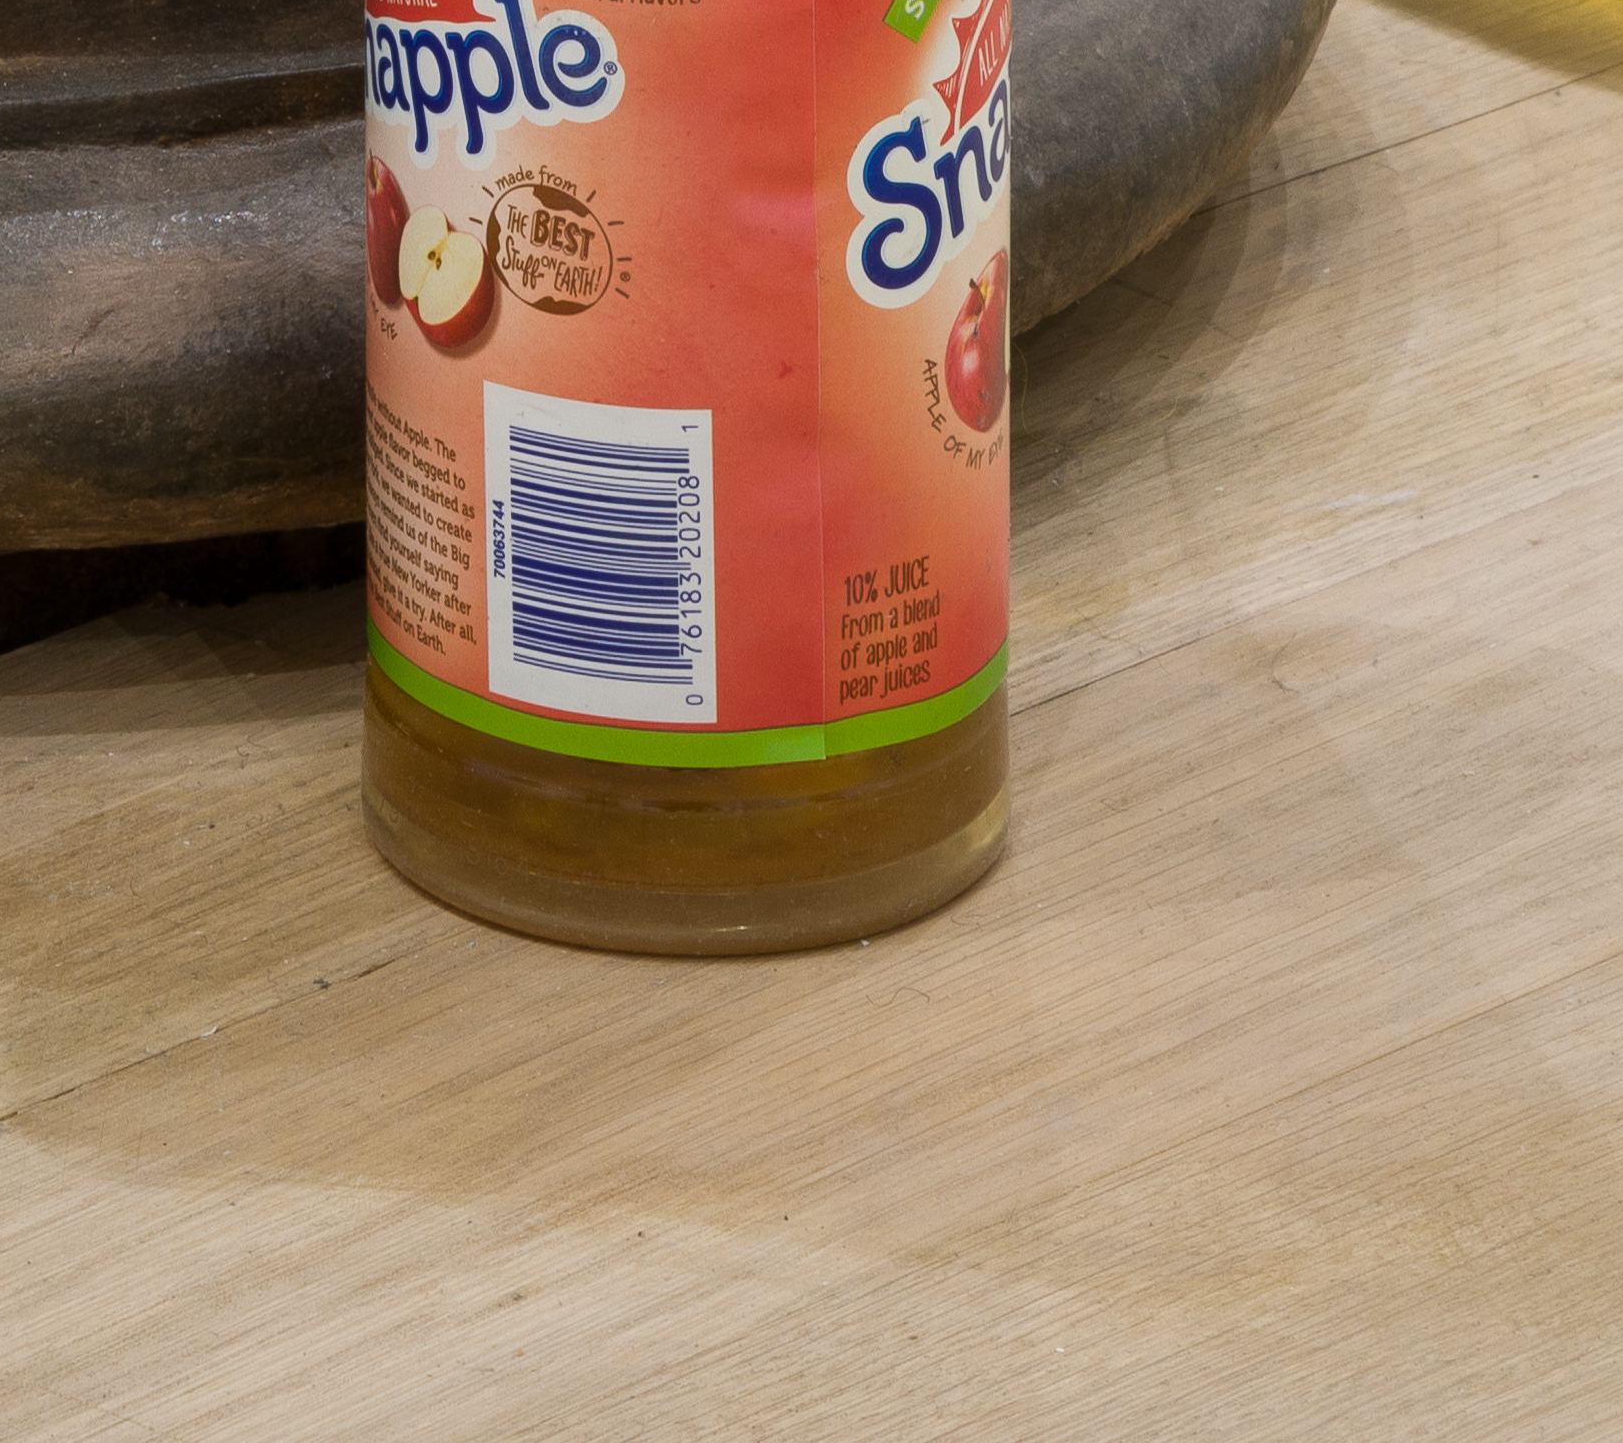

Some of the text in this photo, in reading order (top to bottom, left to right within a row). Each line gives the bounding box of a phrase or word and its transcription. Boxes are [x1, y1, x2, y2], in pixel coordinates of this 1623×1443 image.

[977, 29, 1000, 88] ALL
[494, 163, 579, 197] made from
[506, 203, 596, 262] THE BEST
[501, 233, 603, 299] Stuff ON EARTH!
[922, 358, 986, 471] APPLE OF MY
[403, 419, 433, 452] Apple.
[434, 436, 457, 463] The
[412, 448, 451, 486] begged
[453, 471, 466, 492] to
[406, 474, 419, 494] we
[420, 482, 459, 513] started
[461, 501, 476, 519] as
[405, 522, 416, 541] us
[417, 531, 429, 548] of
[429, 535, 448, 558] the
[450, 542, 471, 571] Big
[422, 507, 434, 526] to
[435, 516, 473, 544] create
[492, 498, 506, 581] 70063744
[389, 533, 422, 569] yourself
[423, 558, 459, 591] saying
[391, 555, 409, 585] New
[409, 570, 443, 604] Yorker
[443, 593, 472, 617] after
[677, 424, 704, 706] 0 76183 20208 1
[844, 554, 930, 607] 10% JUICE
[402, 619, 415, 638] on
[404, 595, 411, 611] a
[411, 597, 428, 623] try.
[429, 608, 457, 636] After
[841, 587, 941, 640] From a blend
[840, 620, 939, 671] of apple and
[839, 658, 931, 706] pear juices
